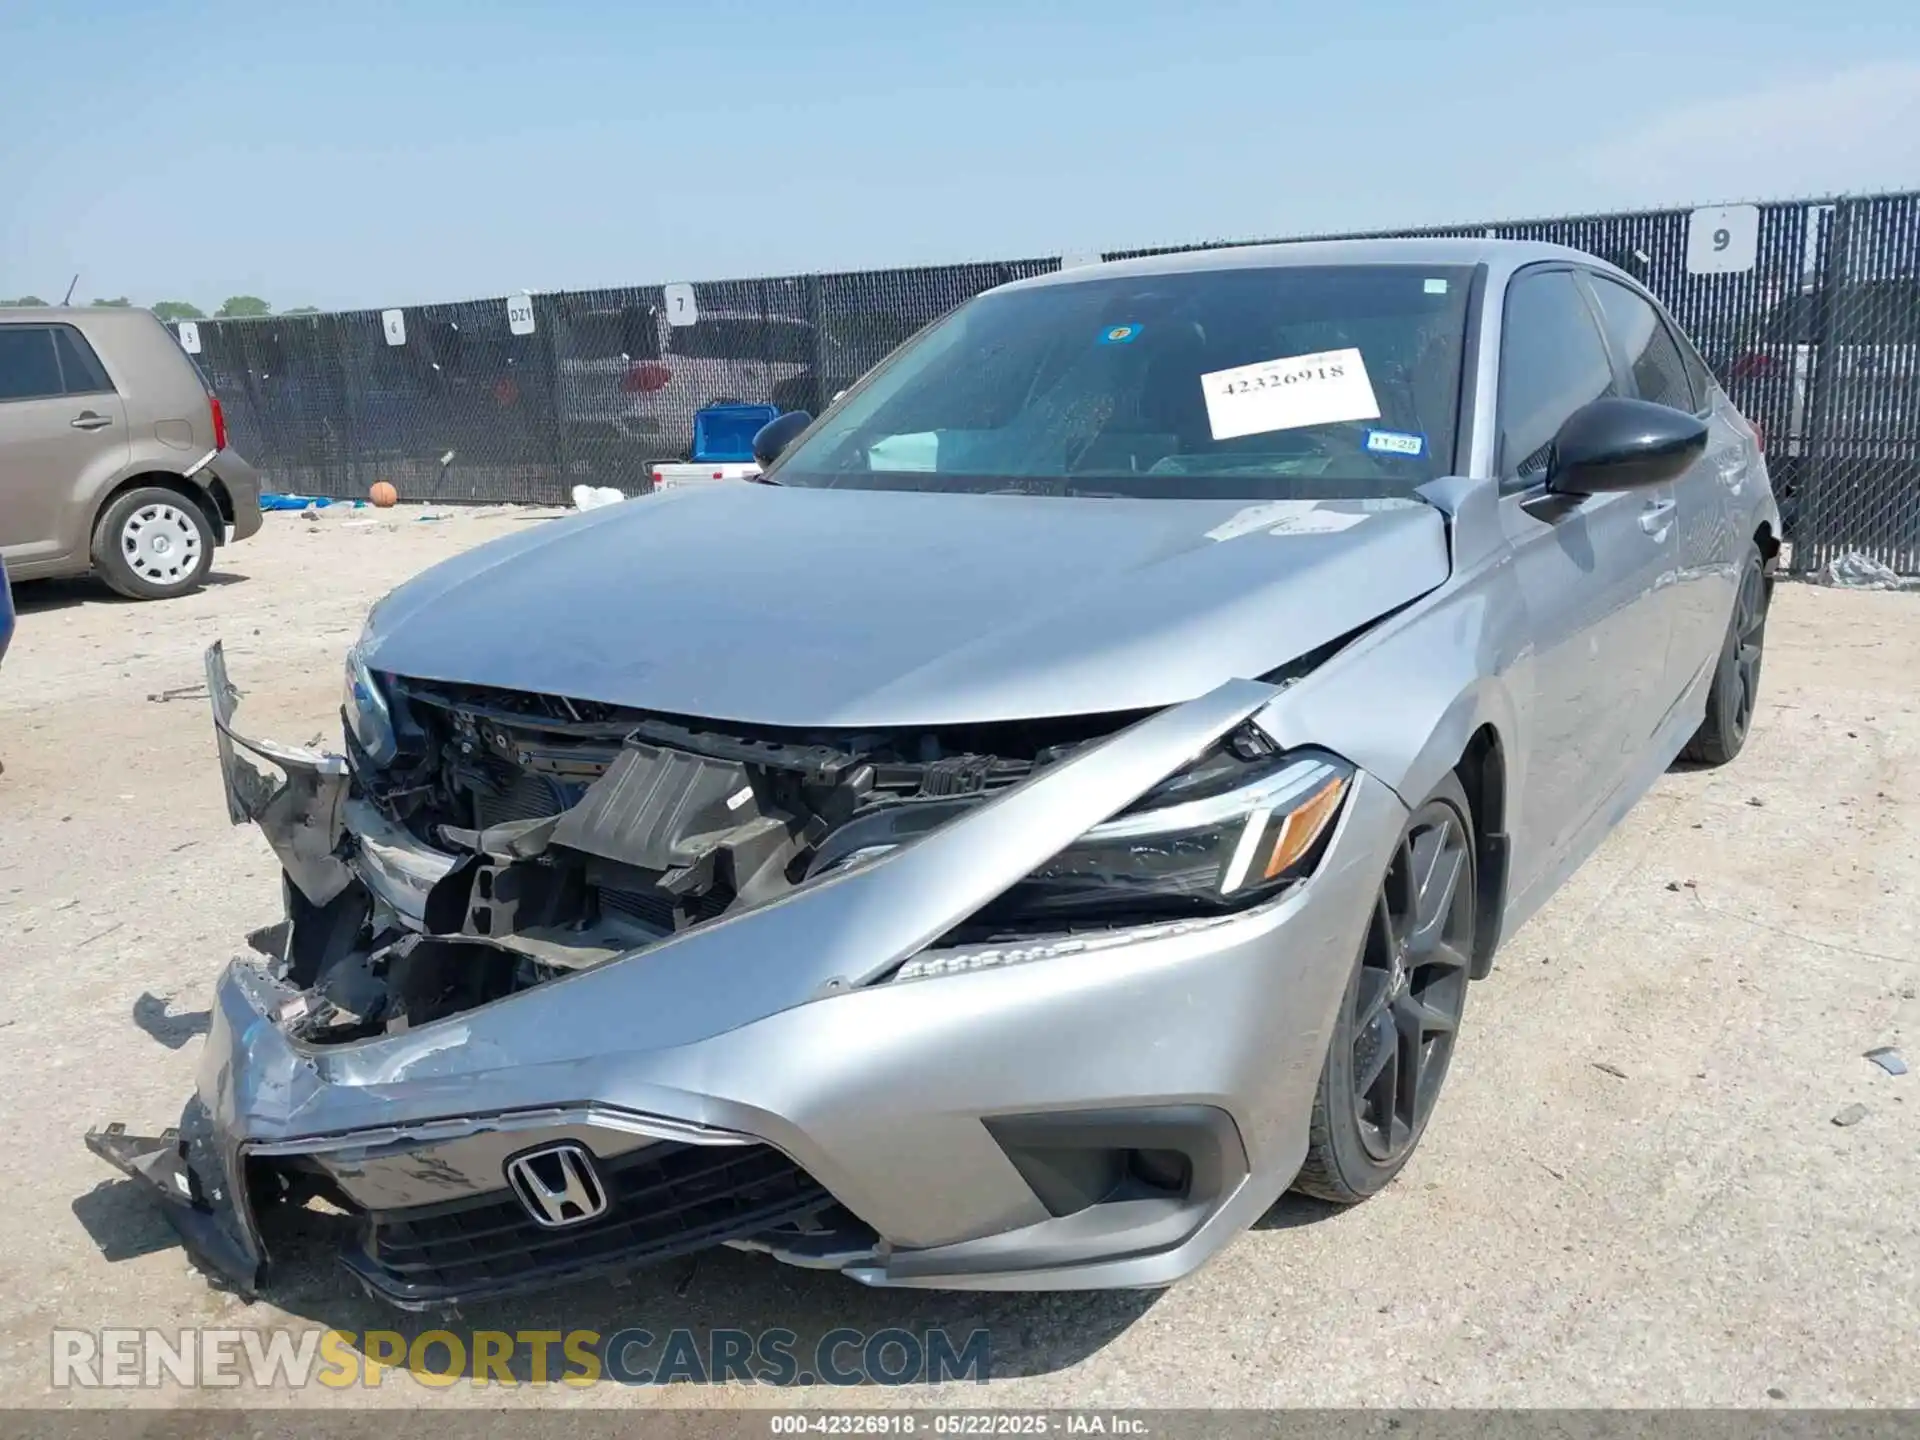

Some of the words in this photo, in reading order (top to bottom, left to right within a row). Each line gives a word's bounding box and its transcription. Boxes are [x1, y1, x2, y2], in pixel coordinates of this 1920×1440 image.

[1713, 228, 1730, 252] 9
[676, 297, 684, 312] 7
[511, 307, 531, 322] DZ1
[1221, 364, 1345, 396] 42326918
